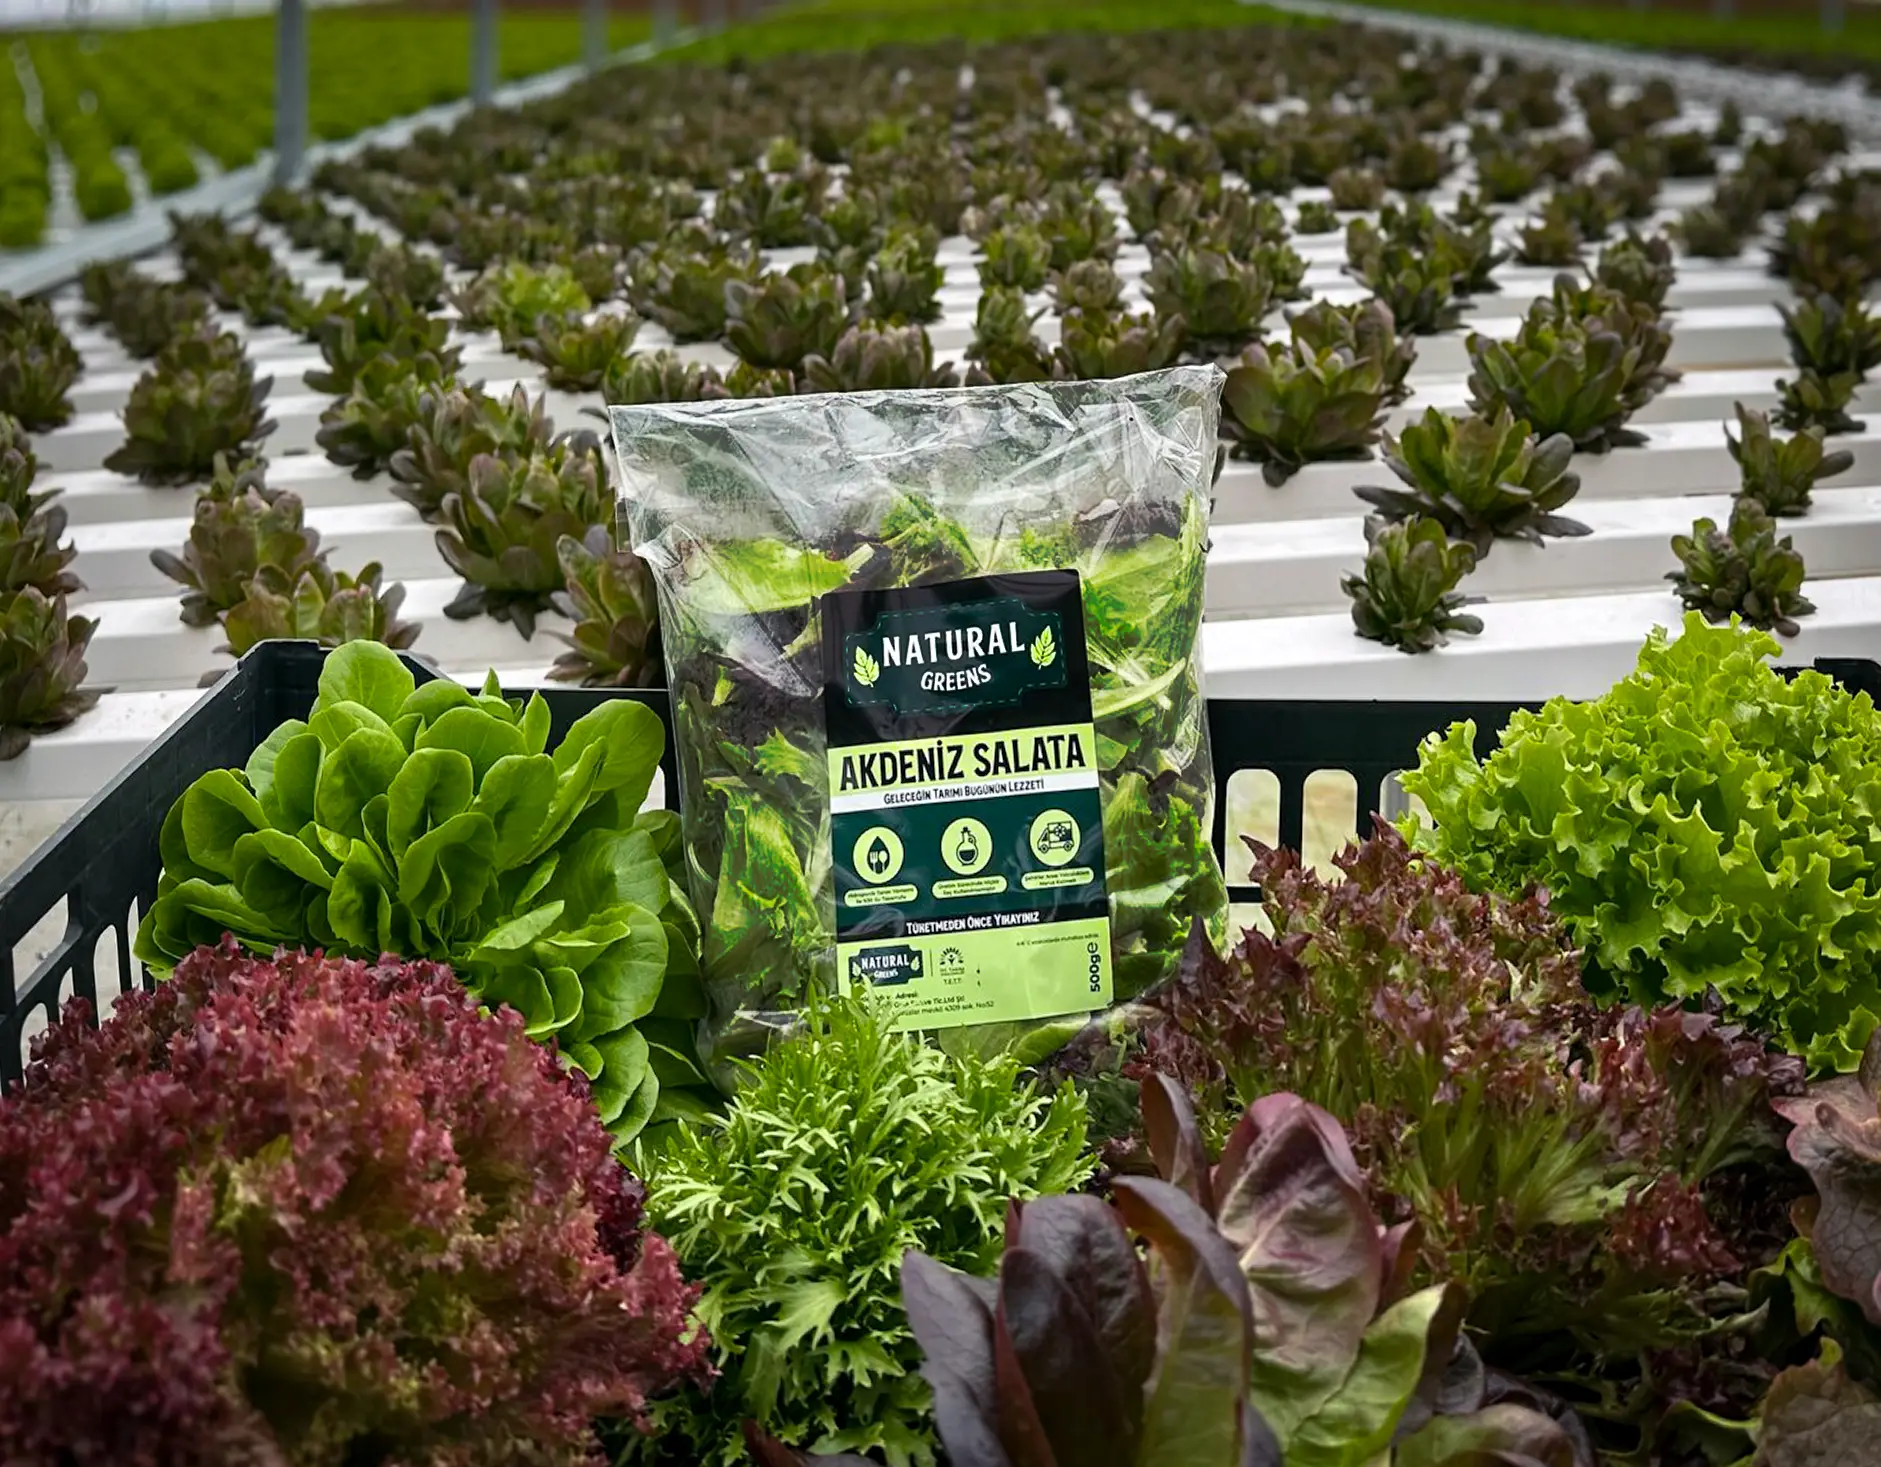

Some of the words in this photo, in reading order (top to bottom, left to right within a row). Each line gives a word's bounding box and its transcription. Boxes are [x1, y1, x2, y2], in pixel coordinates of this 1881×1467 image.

[882, 621, 1026, 668] NATURAL
[920, 664, 992, 692] GREENS
[840, 740, 965, 791] AKDENİZ
[973, 733, 1087, 777] SALATA
[861, 953, 910, 970] NATURAL
